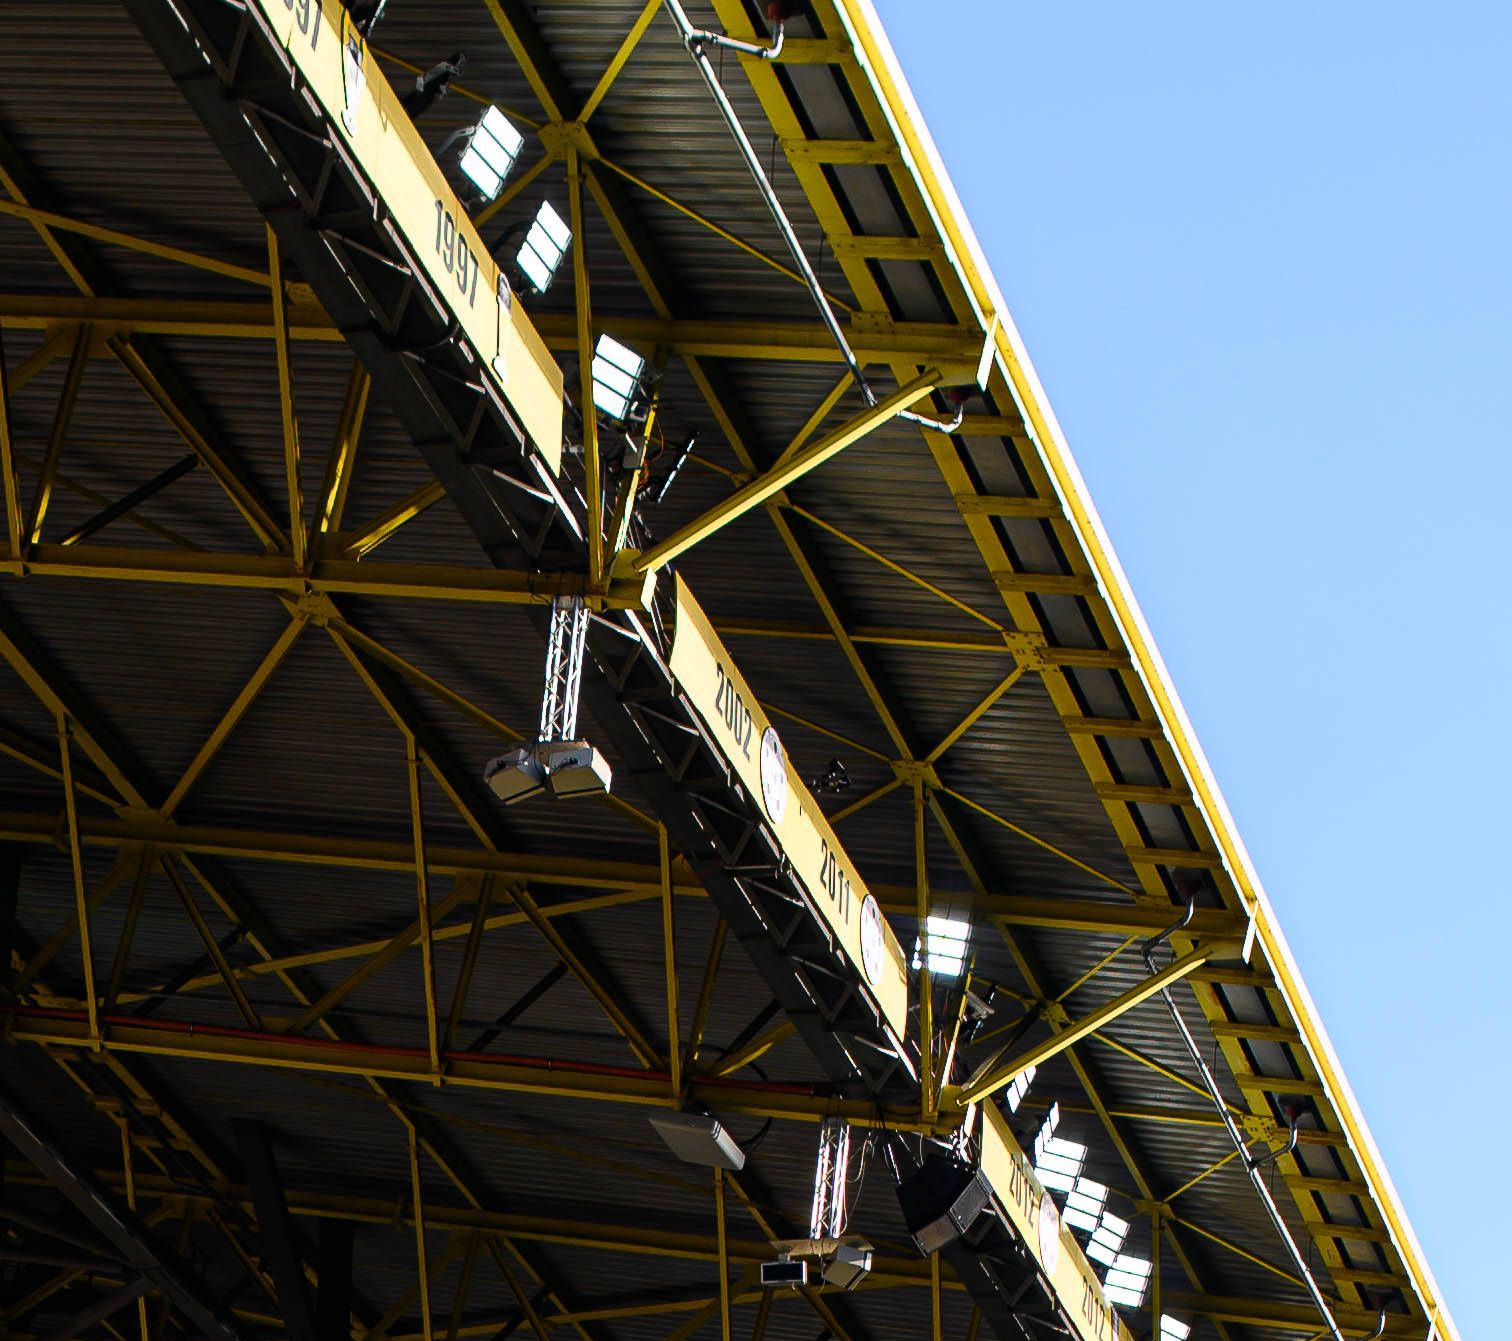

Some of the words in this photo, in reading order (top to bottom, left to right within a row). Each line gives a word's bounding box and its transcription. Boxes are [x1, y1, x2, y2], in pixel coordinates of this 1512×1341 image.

[434, 200, 479, 309] 1997
[715, 662, 752, 762] 2002
[820, 838, 850, 925] 2011
[1009, 1154, 1034, 1228] 2012
